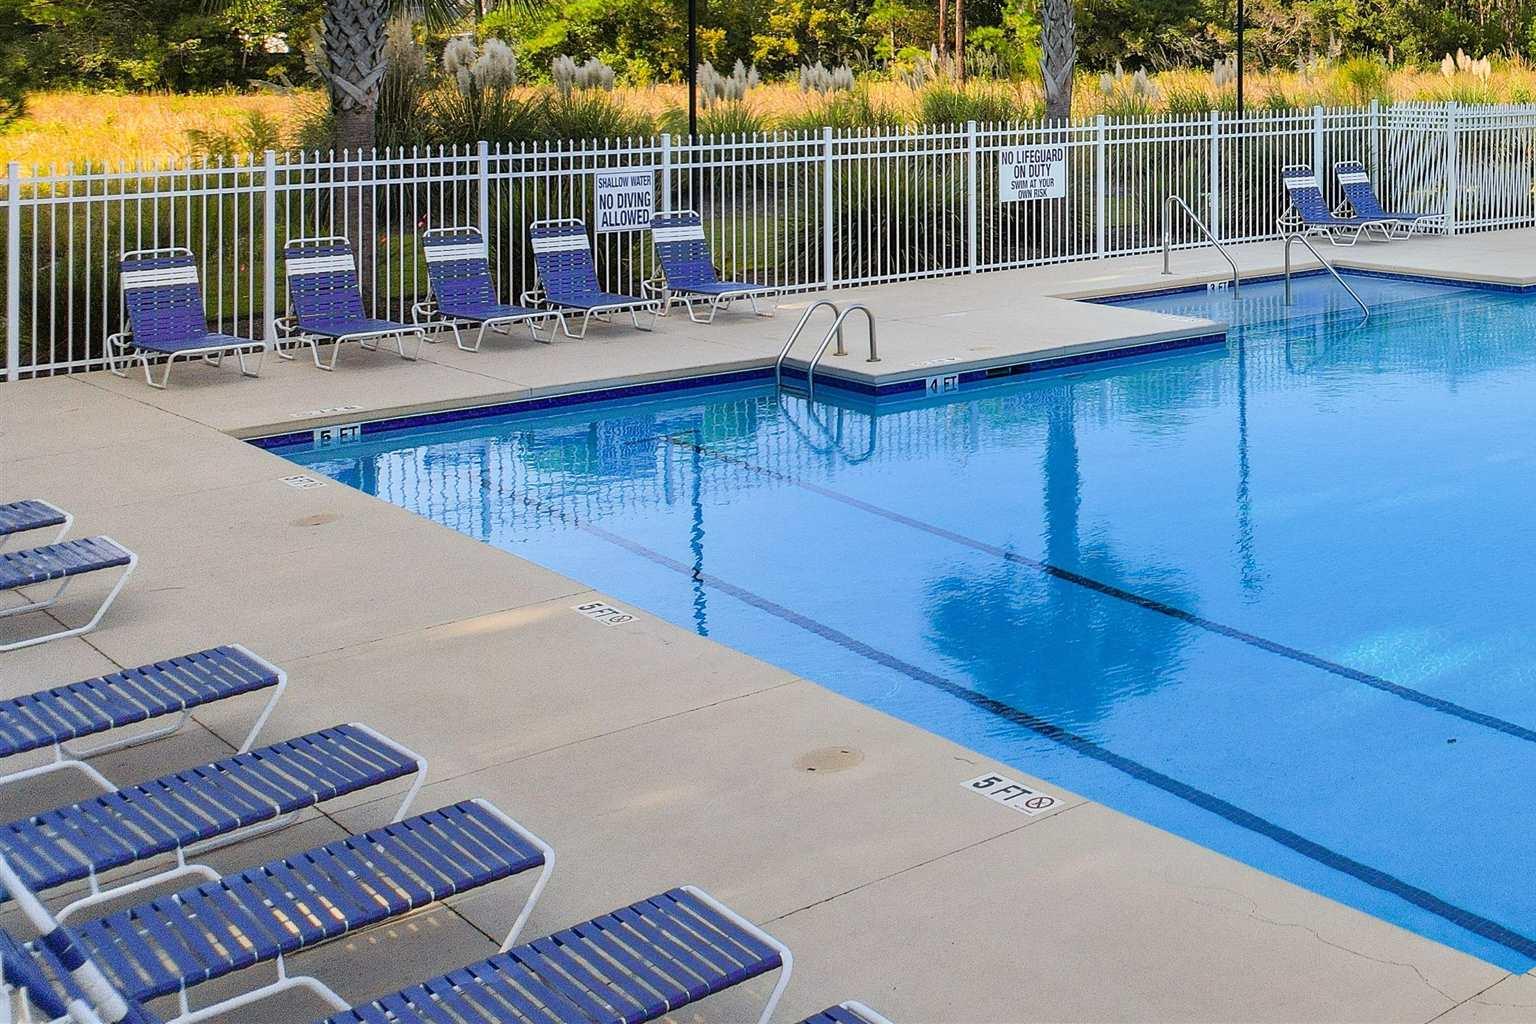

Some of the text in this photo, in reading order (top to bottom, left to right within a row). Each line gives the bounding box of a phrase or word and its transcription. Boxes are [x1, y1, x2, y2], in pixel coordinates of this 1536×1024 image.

[1001, 148, 1063, 165] NO LIFEGUARD
[1014, 163, 1051, 179] ON DUTY
[598, 175, 651, 189] SHALLOW WATER
[1010, 177, 1055, 190] SWIM AT YOUR
[599, 191, 651, 210] NO DIVING
[1017, 187, 1048, 199] OWN RISK
[601, 209, 650, 228] ALLOWED
[321, 425, 359, 443] 5 FT
[578, 603, 620, 618] 5 FT
[972, 776, 1033, 801] 5 FT
